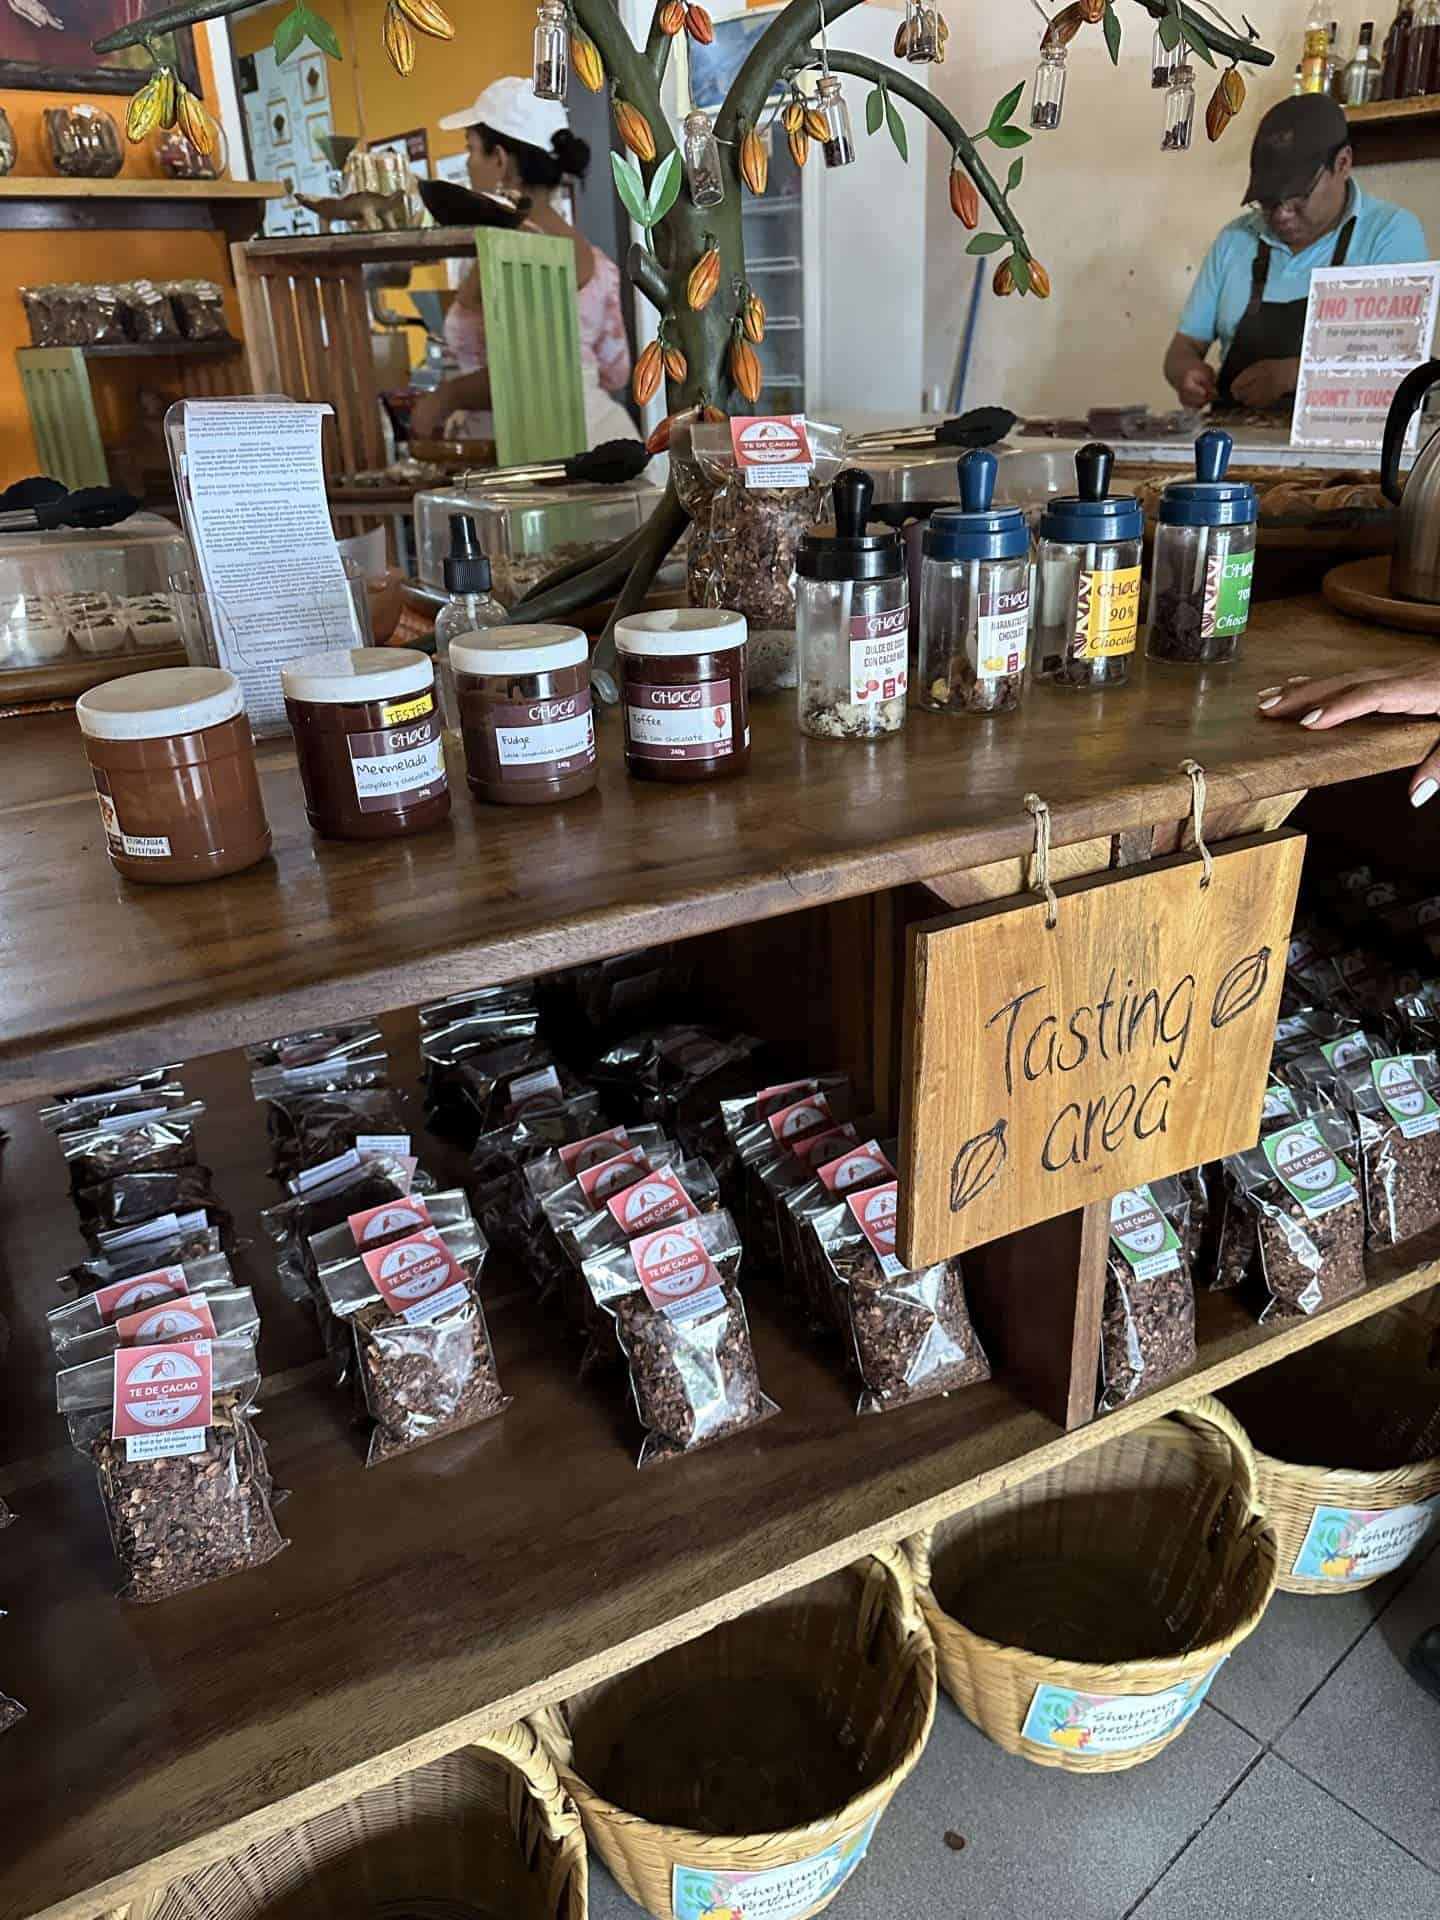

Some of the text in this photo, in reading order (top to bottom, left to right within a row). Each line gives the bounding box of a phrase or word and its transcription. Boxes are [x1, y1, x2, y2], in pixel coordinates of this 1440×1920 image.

[650, 689, 701, 704] CHOCO
[528, 699, 576, 720] CHOCO
[389, 724, 432, 748] CHOCO
[985, 967, 1196, 1098] Tasting
[1041, 1075, 1172, 1172] area
[655, 1198, 680, 1218] CACAO
[649, 1255, 699, 1278] TE DE CACAO
[129, 1381, 198, 1397] TE DE CACAO
